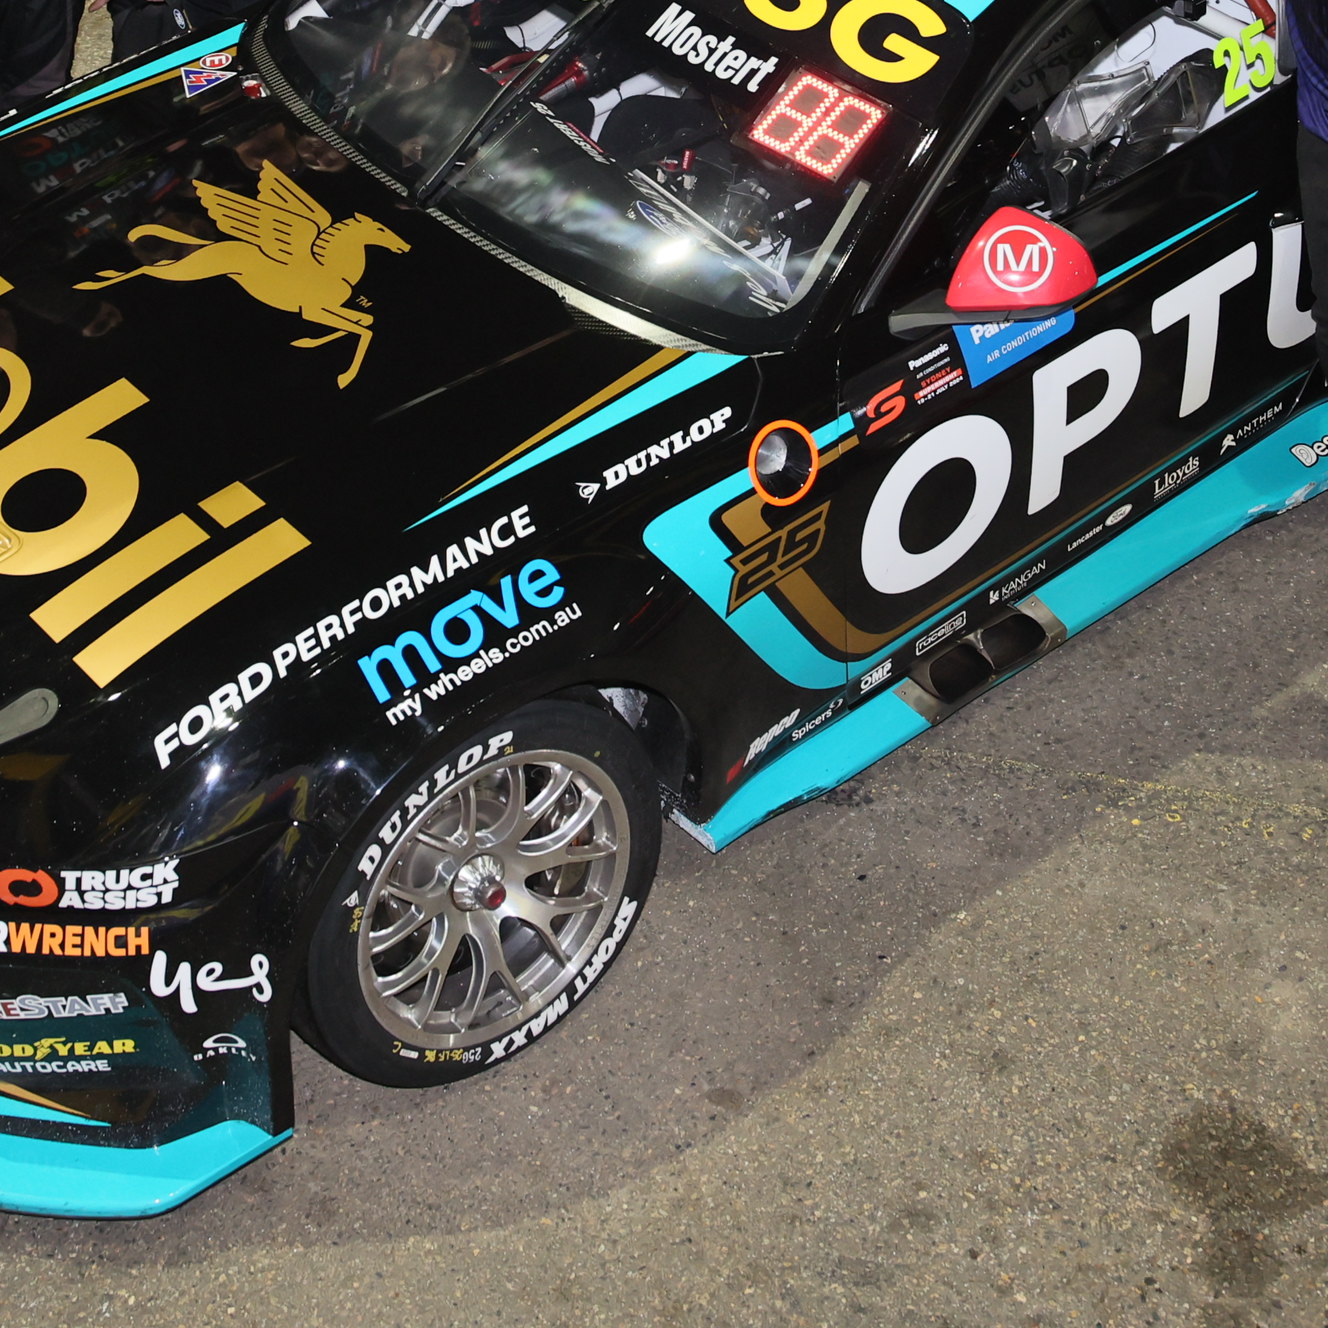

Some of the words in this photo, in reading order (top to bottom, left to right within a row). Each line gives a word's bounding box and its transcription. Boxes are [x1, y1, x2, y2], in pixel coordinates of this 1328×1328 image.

[645, 3, 779, 93] Mostert
[1212, 21, 1275, 108] 25
[907, 343, 950, 371] Panasonic
[987, 350, 1001, 364] AIR
[1001, 317, 1057, 355] CONDITIONING
[915, 369, 924, 379] AIR
[923, 356, 951, 376] CONDITIONING
[918, 370, 959, 397] SUPERNIGHT
[920, 367, 951, 387] SYDNEY
[860, 222, 1320, 594] OPTU
[916, 391, 935, 405] 19-21
[935, 383, 948, 396] JULY
[947, 375, 964, 389] 2024
[1236, 402, 1283, 439] ANTHEM
[603, 406, 733, 490] DUNLOP
[1153, 455, 1200, 495] Lloyds
[1067, 523, 1104, 552] Lancaster
[726, 501, 830, 616] 25
[1000, 559, 1048, 597] KANGAN
[356, 557, 566, 704] move
[918, 614, 964, 651] raceline
[385, 690, 424, 727] my
[420, 602, 583, 702] wheels.com.au
[860, 662, 893, 690] OMP
[744, 708, 801, 767] Repco
[791, 708, 833, 742] Spicers
[357, 730, 514, 880] DUNLOP
[60, 859, 180, 890] TRUCK
[58, 886, 179, 911] ASSIST
[573, 895, 639, 1002] SPORT
[149, 950, 272, 1014] yes
[485, 991, 570, 1065] MAXX
[192, 1046, 257, 1063] OAKLEY
